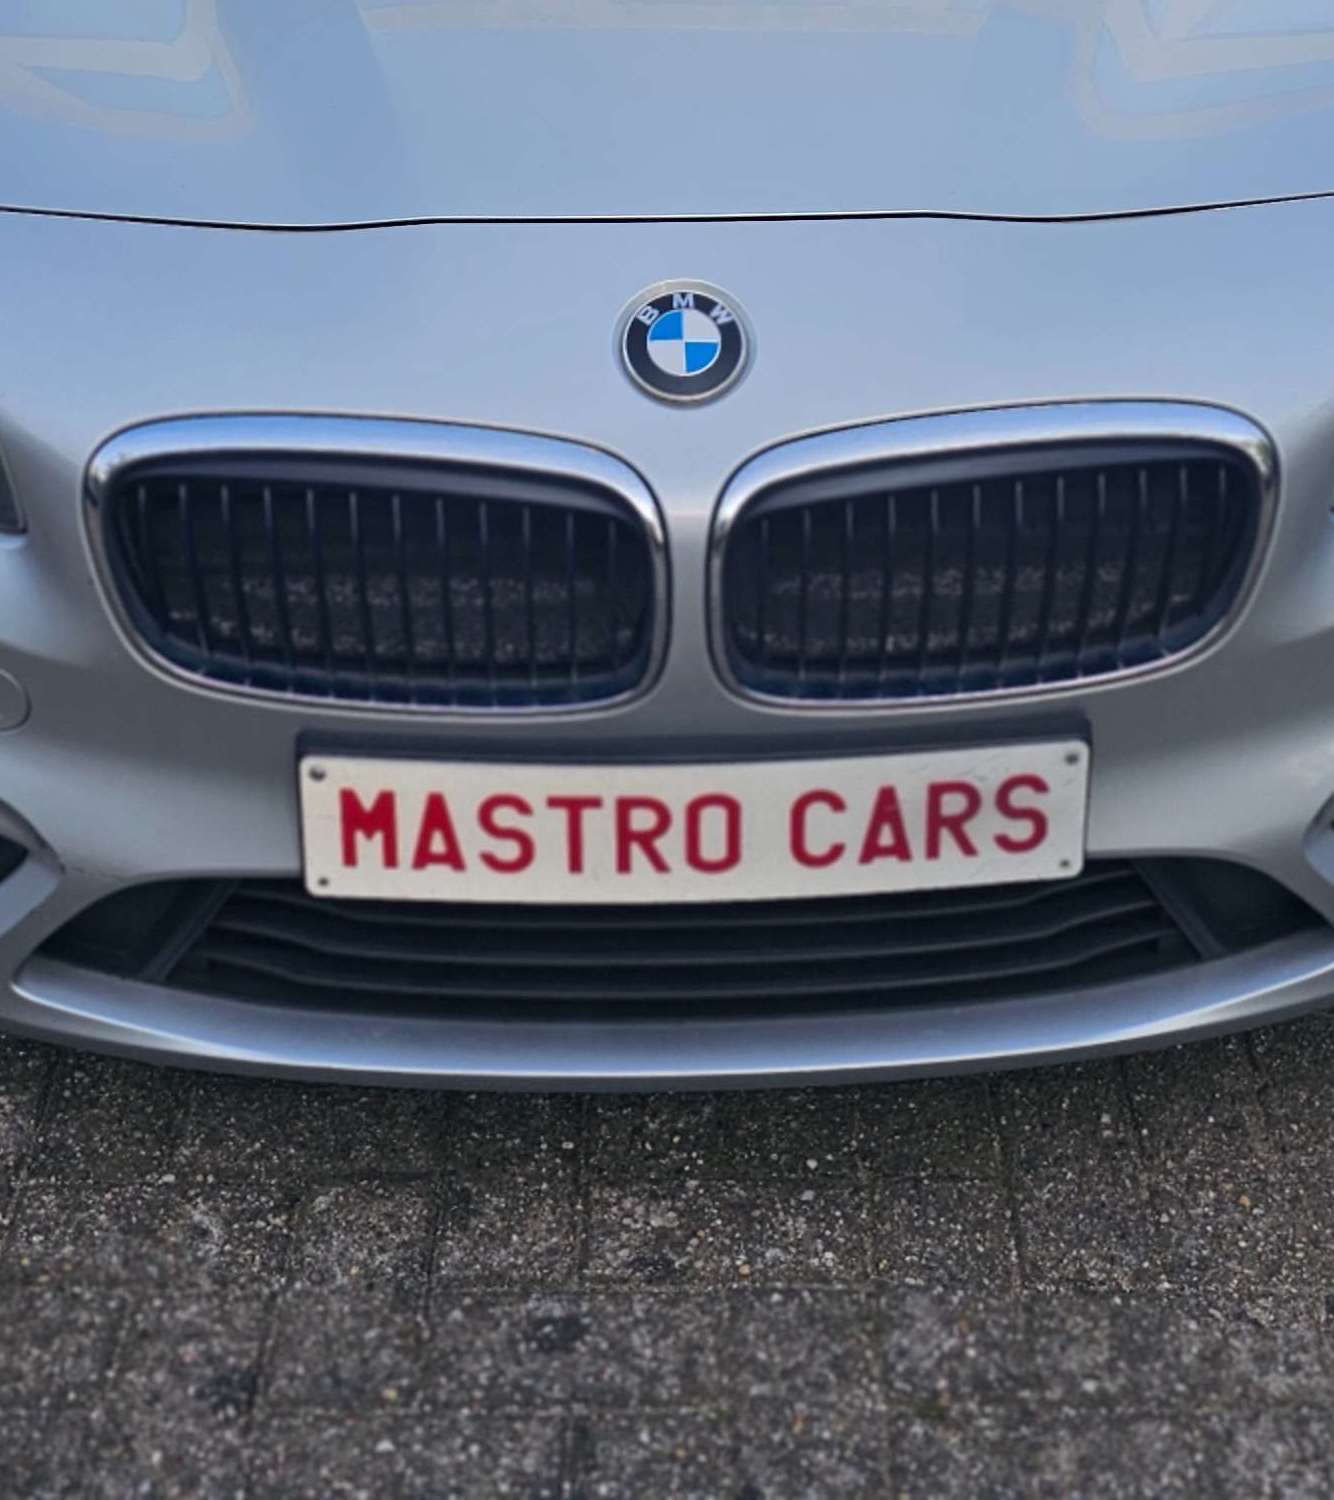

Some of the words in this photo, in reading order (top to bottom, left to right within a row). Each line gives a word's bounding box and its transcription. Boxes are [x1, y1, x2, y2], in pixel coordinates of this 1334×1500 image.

[636, 291, 735, 325] BMW
[339, 788, 742, 874] MASTRO
[789, 773, 1050, 868] CARS
